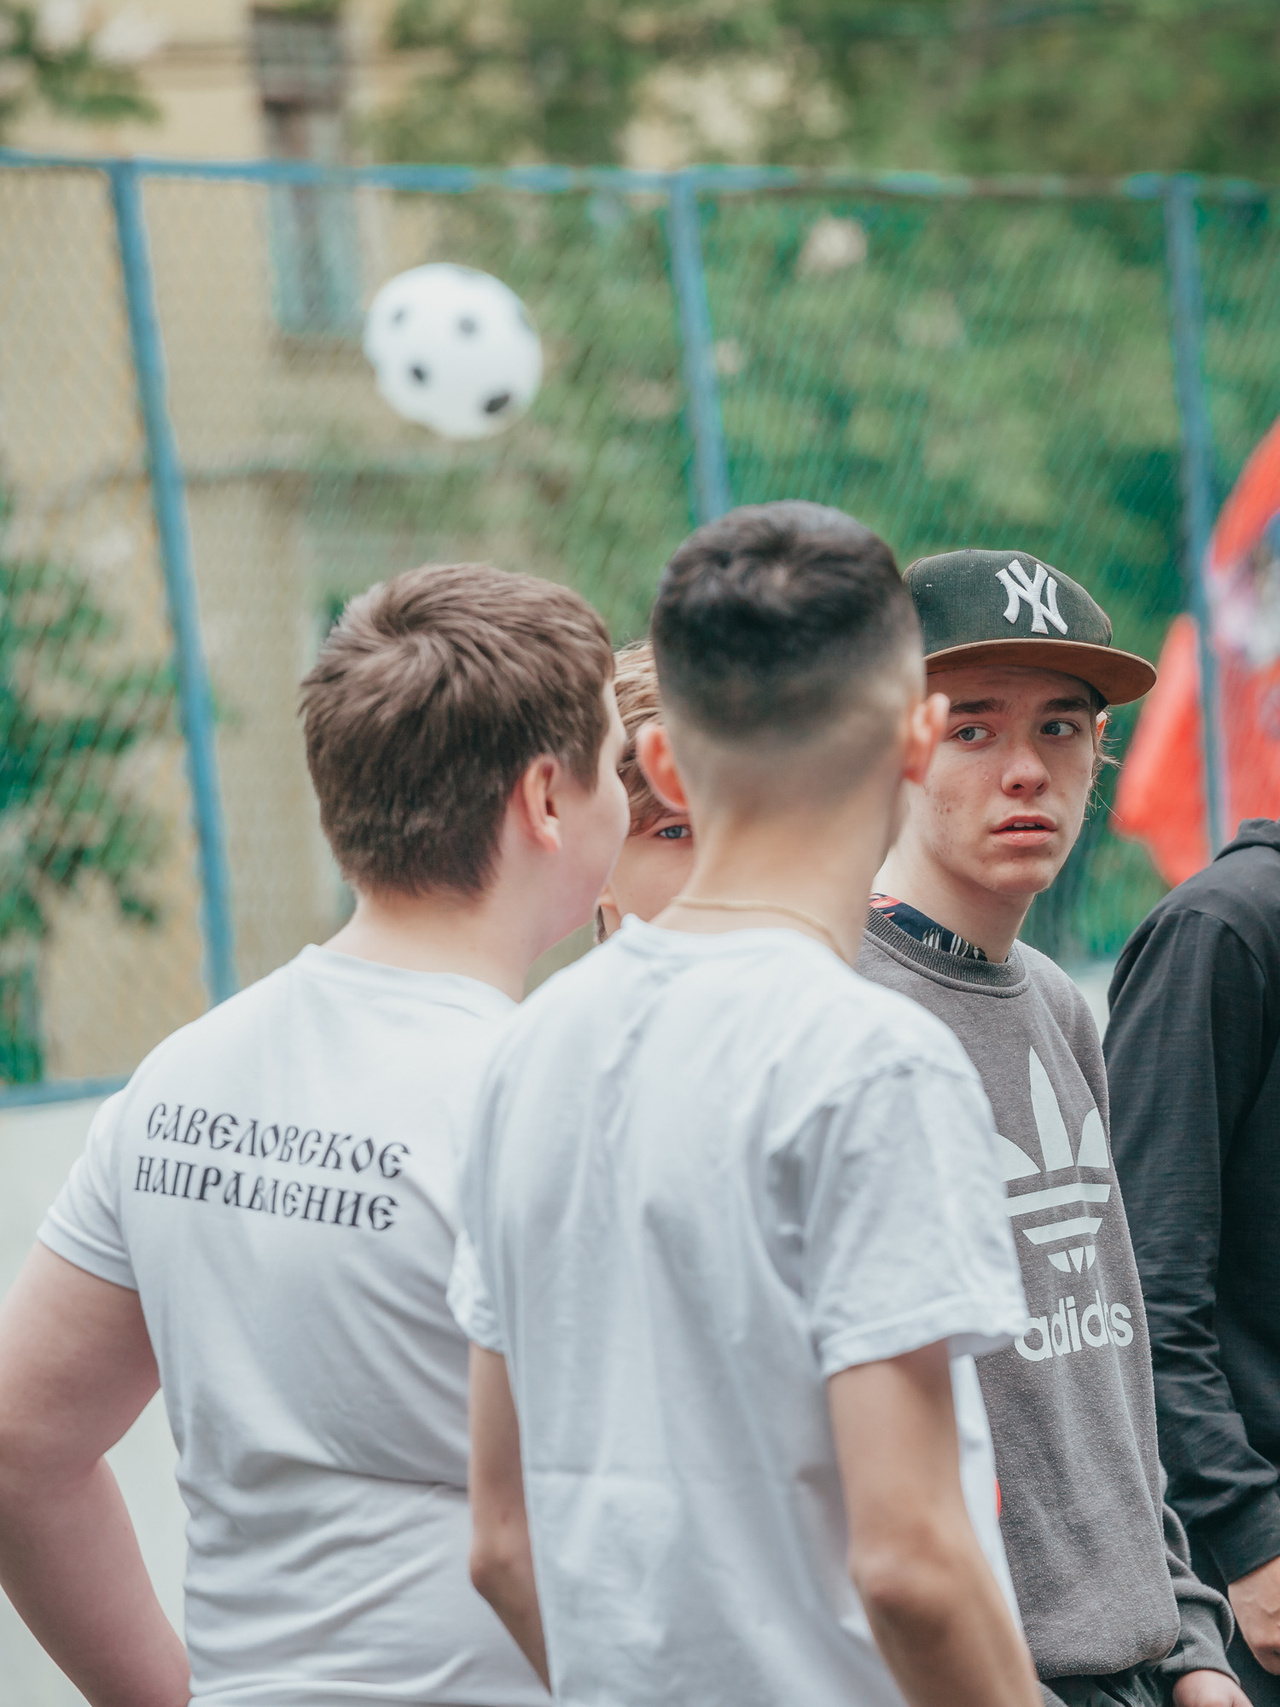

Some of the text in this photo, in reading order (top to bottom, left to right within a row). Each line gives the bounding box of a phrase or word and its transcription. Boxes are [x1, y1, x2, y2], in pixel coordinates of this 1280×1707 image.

[994, 559, 1068, 635] NY
[147, 1102, 410, 1179] САВЕЛОВСКОЕ
[135, 1155, 397, 1231] НАПРАВЛЕНИЕ
